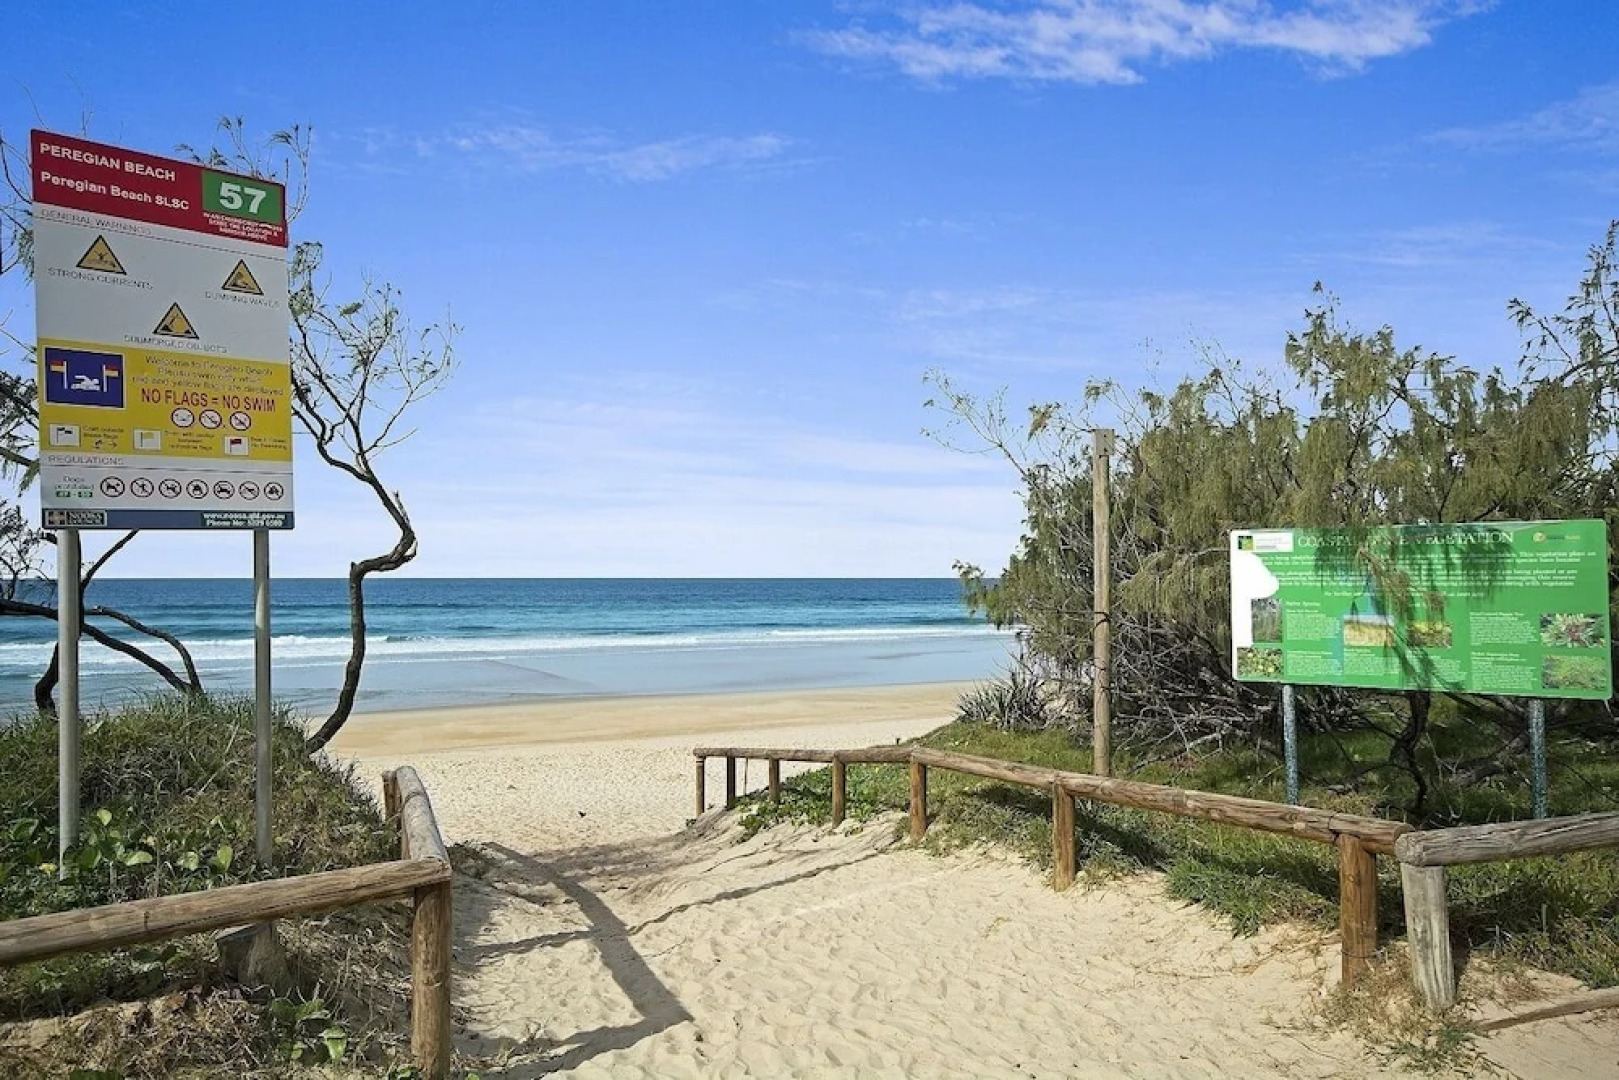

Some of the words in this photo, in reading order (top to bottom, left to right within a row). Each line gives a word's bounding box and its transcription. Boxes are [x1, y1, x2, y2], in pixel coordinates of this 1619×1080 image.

[40, 143, 120, 169] PEREGIAN
[124, 161, 176, 181] BEACH
[41, 171, 107, 195] Peregian
[111, 185, 152, 203] Beach
[155, 194, 189, 210] SLSC
[220, 182, 266, 214] 57
[41, 208, 90, 224] GENERAL
[95, 219, 151, 235] WARNINGS
[48, 267, 94, 281] STRONG
[97, 275, 153, 290] CURRENTS
[141, 388, 161, 404] NO
[164, 390, 208, 408] FLAGS
[222, 395, 241, 411] NO
[243, 396, 276, 412] SWIM
[48, 455, 125, 465] REGULATIONS
